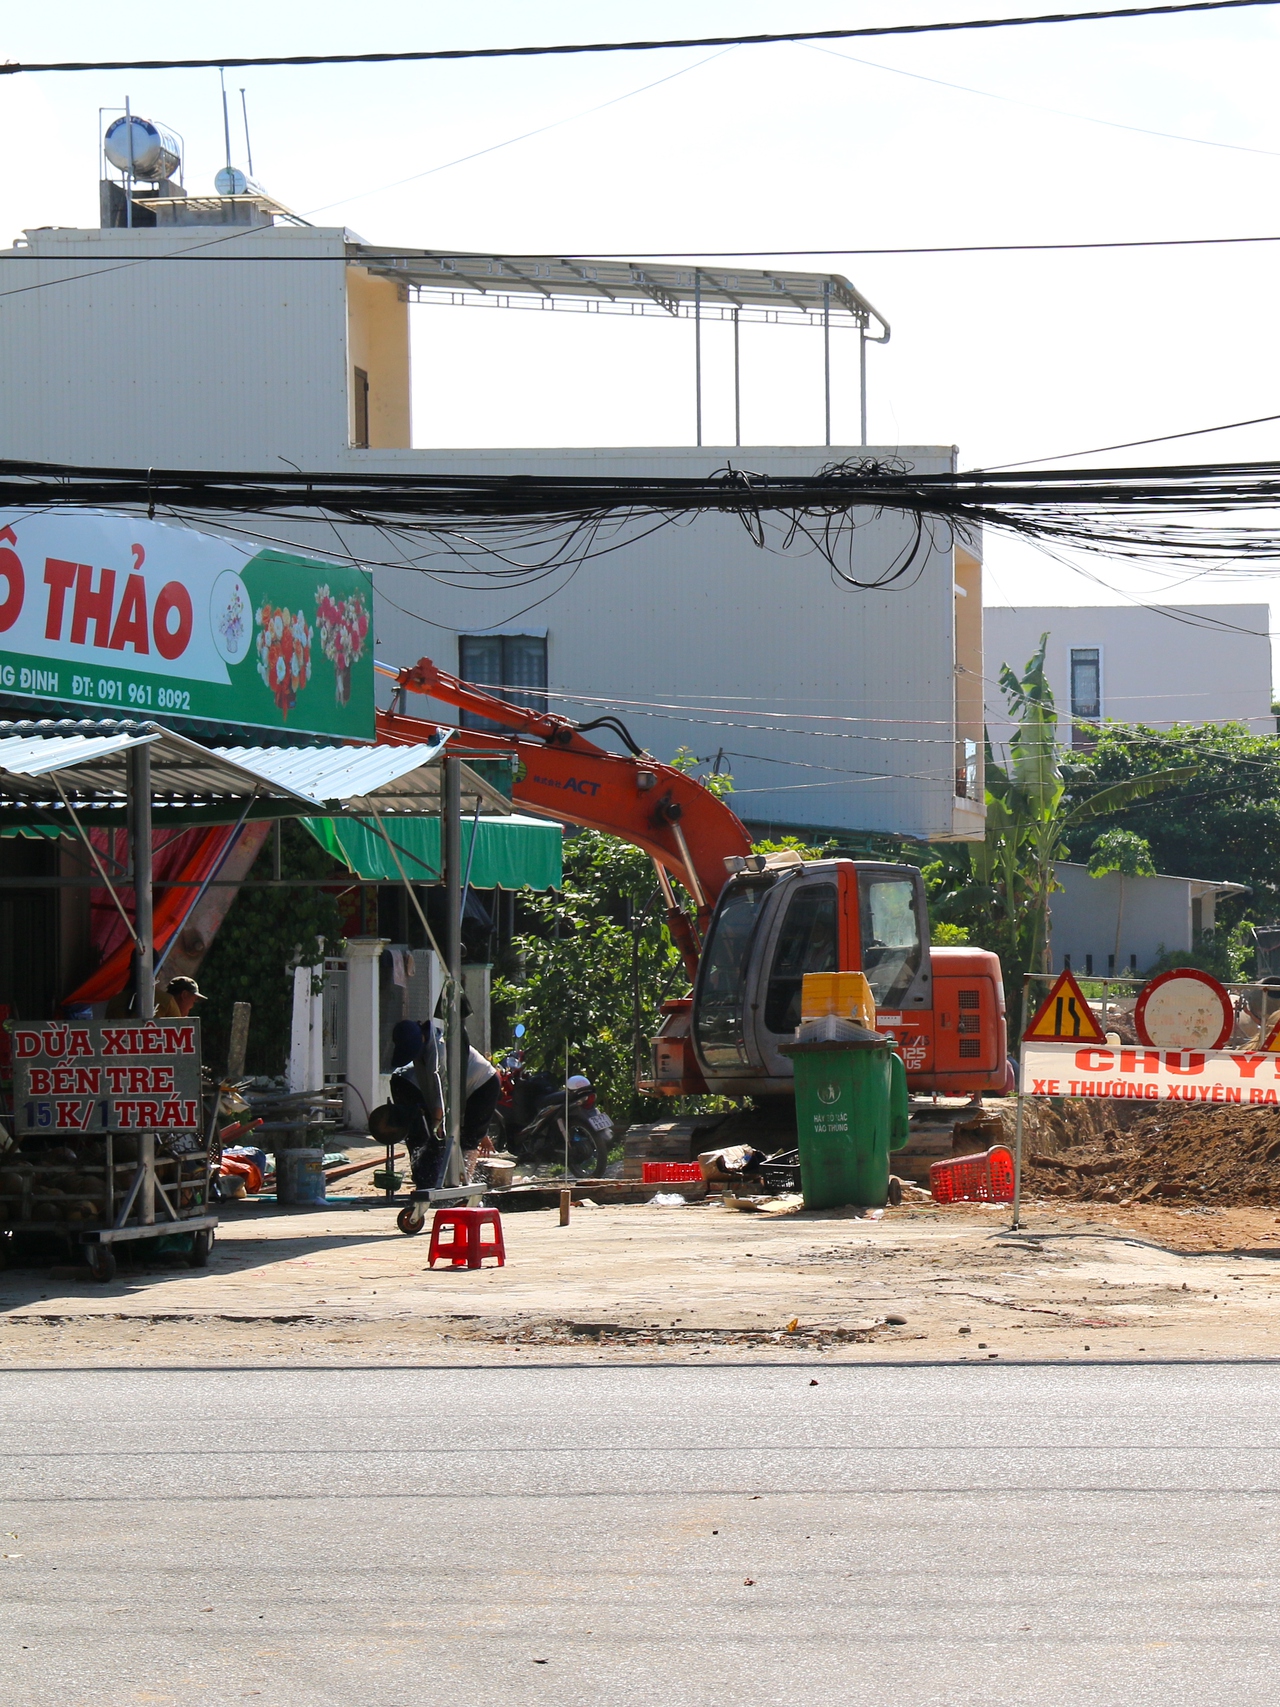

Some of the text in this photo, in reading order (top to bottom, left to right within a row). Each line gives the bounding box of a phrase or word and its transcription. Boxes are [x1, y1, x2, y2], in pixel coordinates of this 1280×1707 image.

[44, 543, 193, 660] THẢO
[20, 668, 59, 695] ĐỊNH
[72, 675, 94, 697] ĐT:
[98, 679, 122, 700] 091
[128, 683, 152, 705] 961
[158, 688, 191, 710] 8092
[563, 777, 601, 797] ACT
[15, 1020, 195, 1058] DỪA XIÊM
[902, 1047, 926, 1060] 125
[29, 1056, 174, 1095] BẾN TRE
[906, 1060, 921, 1070] US
[1074, 1047, 1206, 1076] CHÚ
[1031, 1079, 1059, 1096] XE
[1069, 1078, 1158, 1100] THƯỜNG
[1166, 1082, 1241, 1103] XUYÊN
[1246, 1087, 1280, 1106] RA
[114, 1092, 197, 1128] TRÁI
